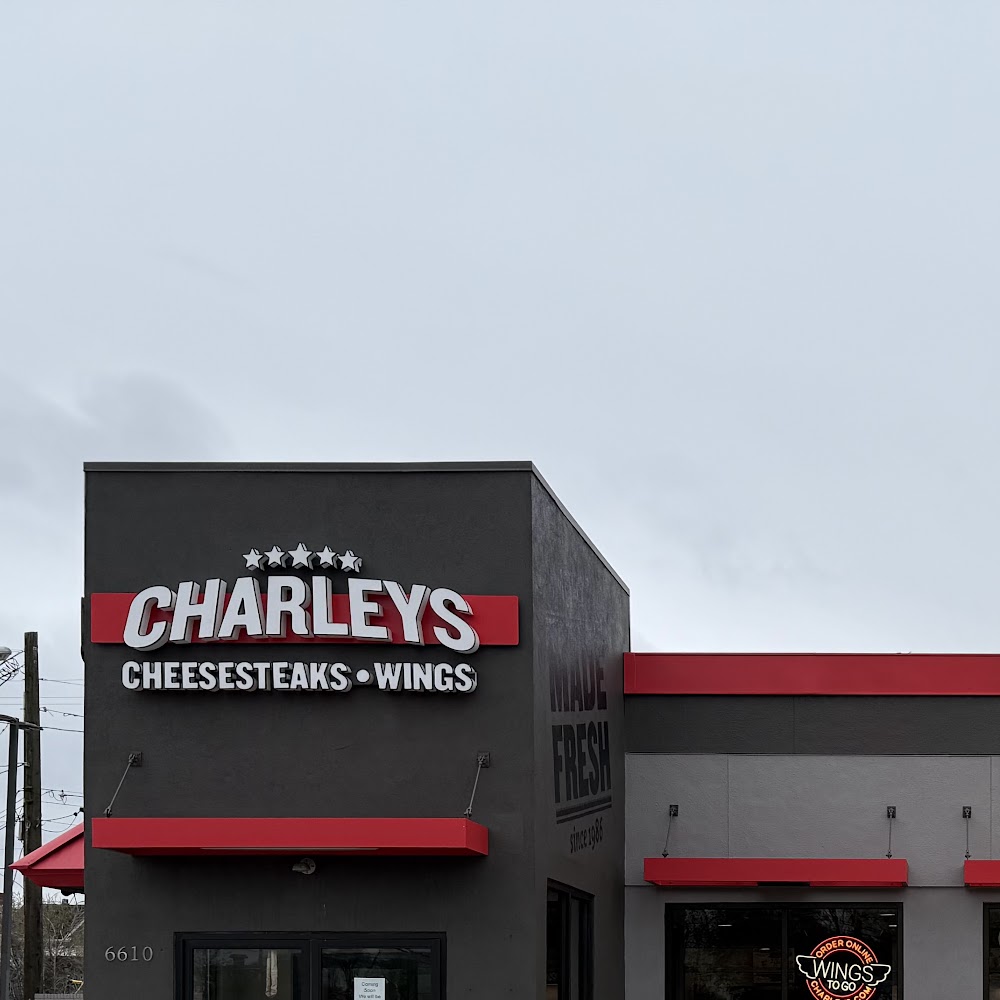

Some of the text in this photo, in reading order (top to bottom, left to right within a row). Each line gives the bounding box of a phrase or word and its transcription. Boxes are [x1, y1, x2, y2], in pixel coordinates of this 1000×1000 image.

[123, 576, 479, 654] CHARLEYS
[121, 660, 477, 693] CHEESESTEAKS WINGS
[551, 721, 611, 809] FRESH
[570, 817, 604, 853] since 1986
[105, 946, 153, 962] 6610
[815, 939, 874, 964] ORDER ONLINE
[813, 959, 874, 983] WINGS
[826, 979, 857, 991] TO GO
